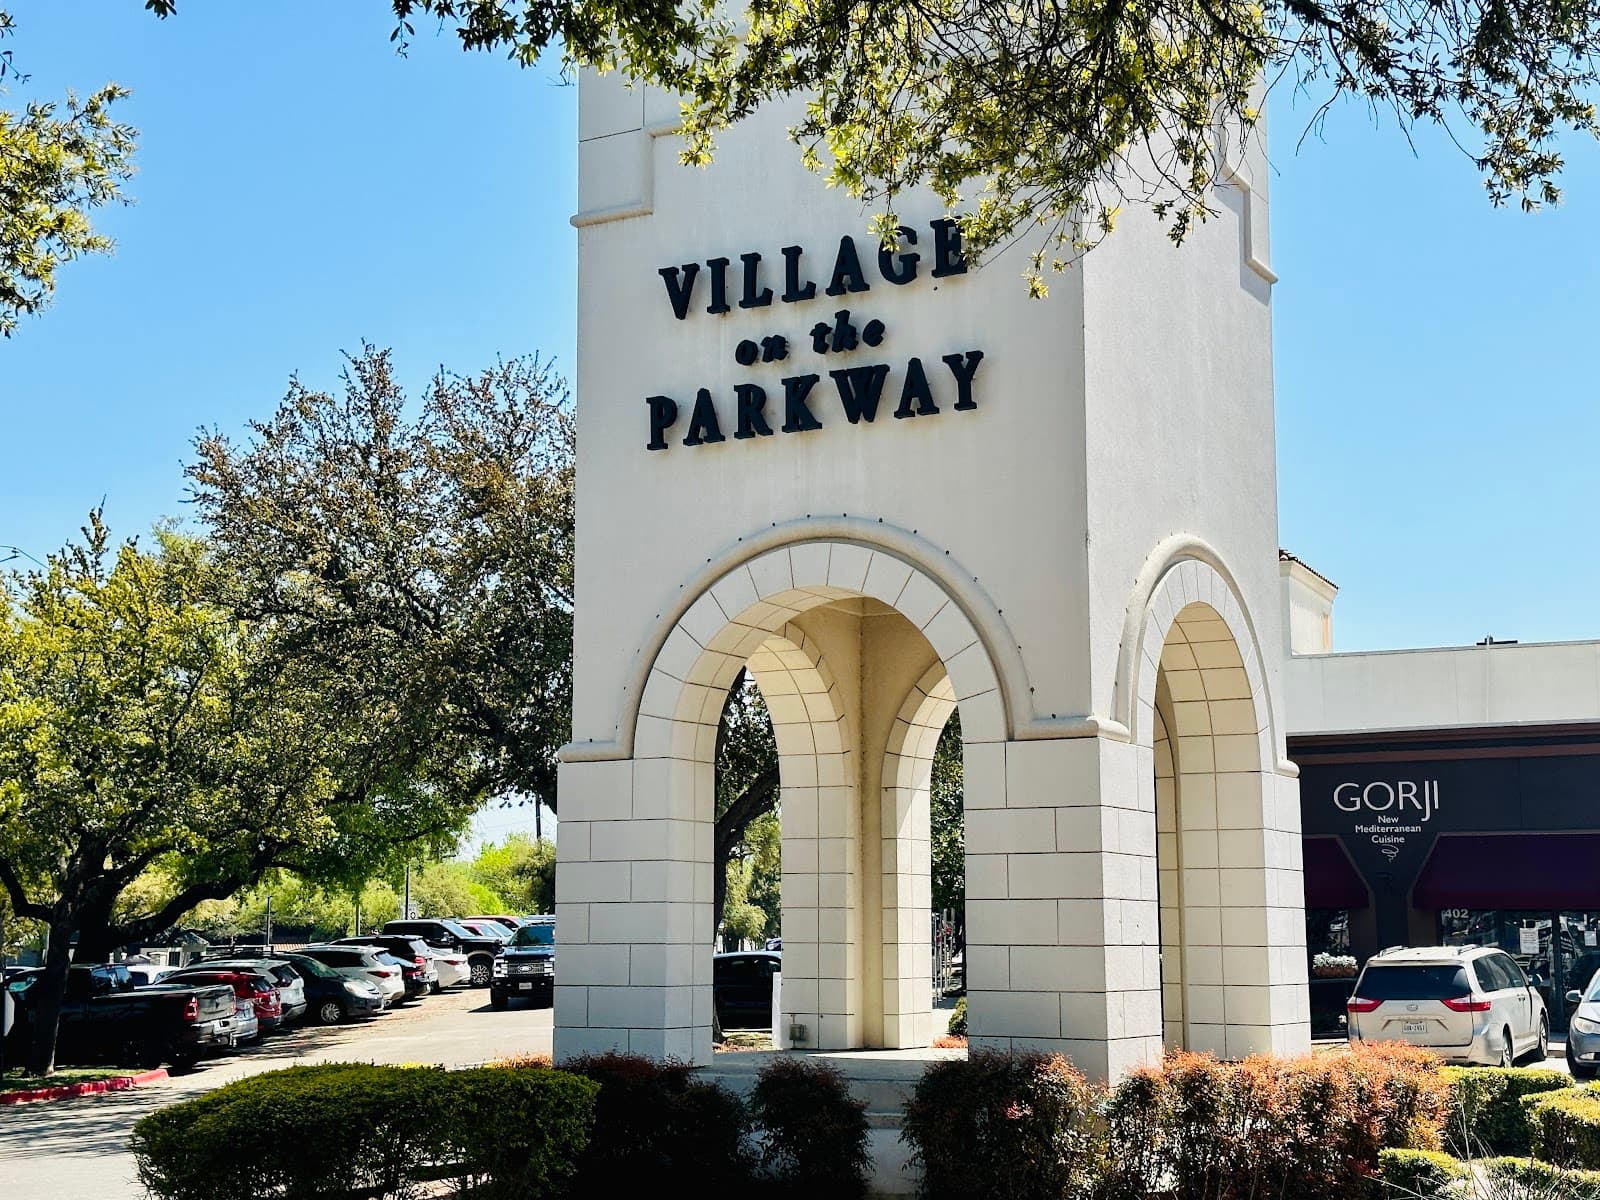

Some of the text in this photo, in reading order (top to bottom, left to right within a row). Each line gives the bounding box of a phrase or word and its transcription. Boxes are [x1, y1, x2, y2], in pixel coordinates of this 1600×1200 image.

[658, 216, 968, 320] VILLAGE
[735, 309, 886, 366] on the
[646, 350, 984, 450] PARKWAY
[1333, 780, 1439, 821] GORJI
[1354, 825, 1422, 833] Mediterranean
[1377, 815, 1399, 824] New
[1371, 835, 1405, 844] Cuisine
[1443, 908, 1469, 919] 402
